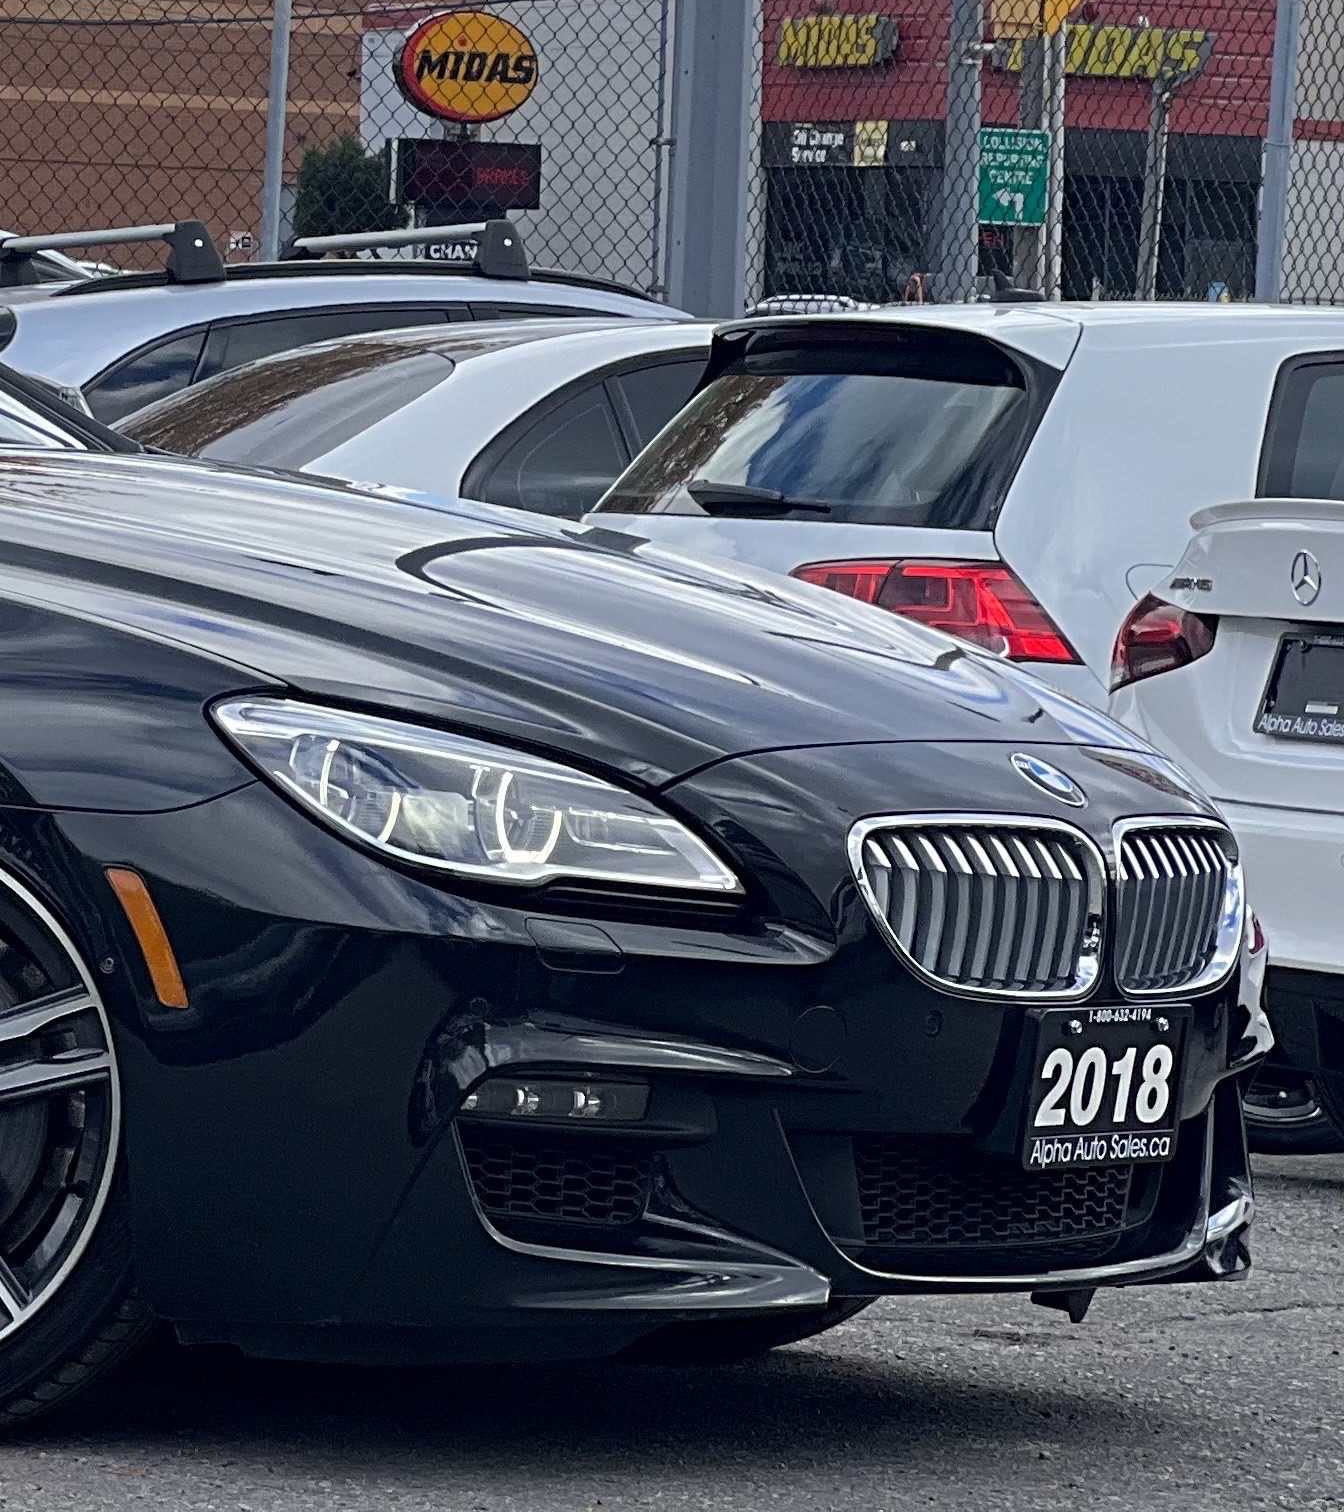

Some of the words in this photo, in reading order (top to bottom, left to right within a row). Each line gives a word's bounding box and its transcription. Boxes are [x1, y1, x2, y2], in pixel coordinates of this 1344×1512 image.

[778, 14, 877, 67] MIDAS
[1007, 24, 1205, 80] IDAS
[416, 49, 537, 84] MIDAS
[429, 244, 479, 261] CHAN
[1258, 714, 1291, 734] Alpha
[1292, 717, 1317, 734] Auto
[1034, 1044, 1173, 1127] 2018
[1029, 1138, 1072, 1168] Alpha
[1073, 1136, 1107, 1161] Auto
[1109, 1134, 1171, 1159] Sales.ca
